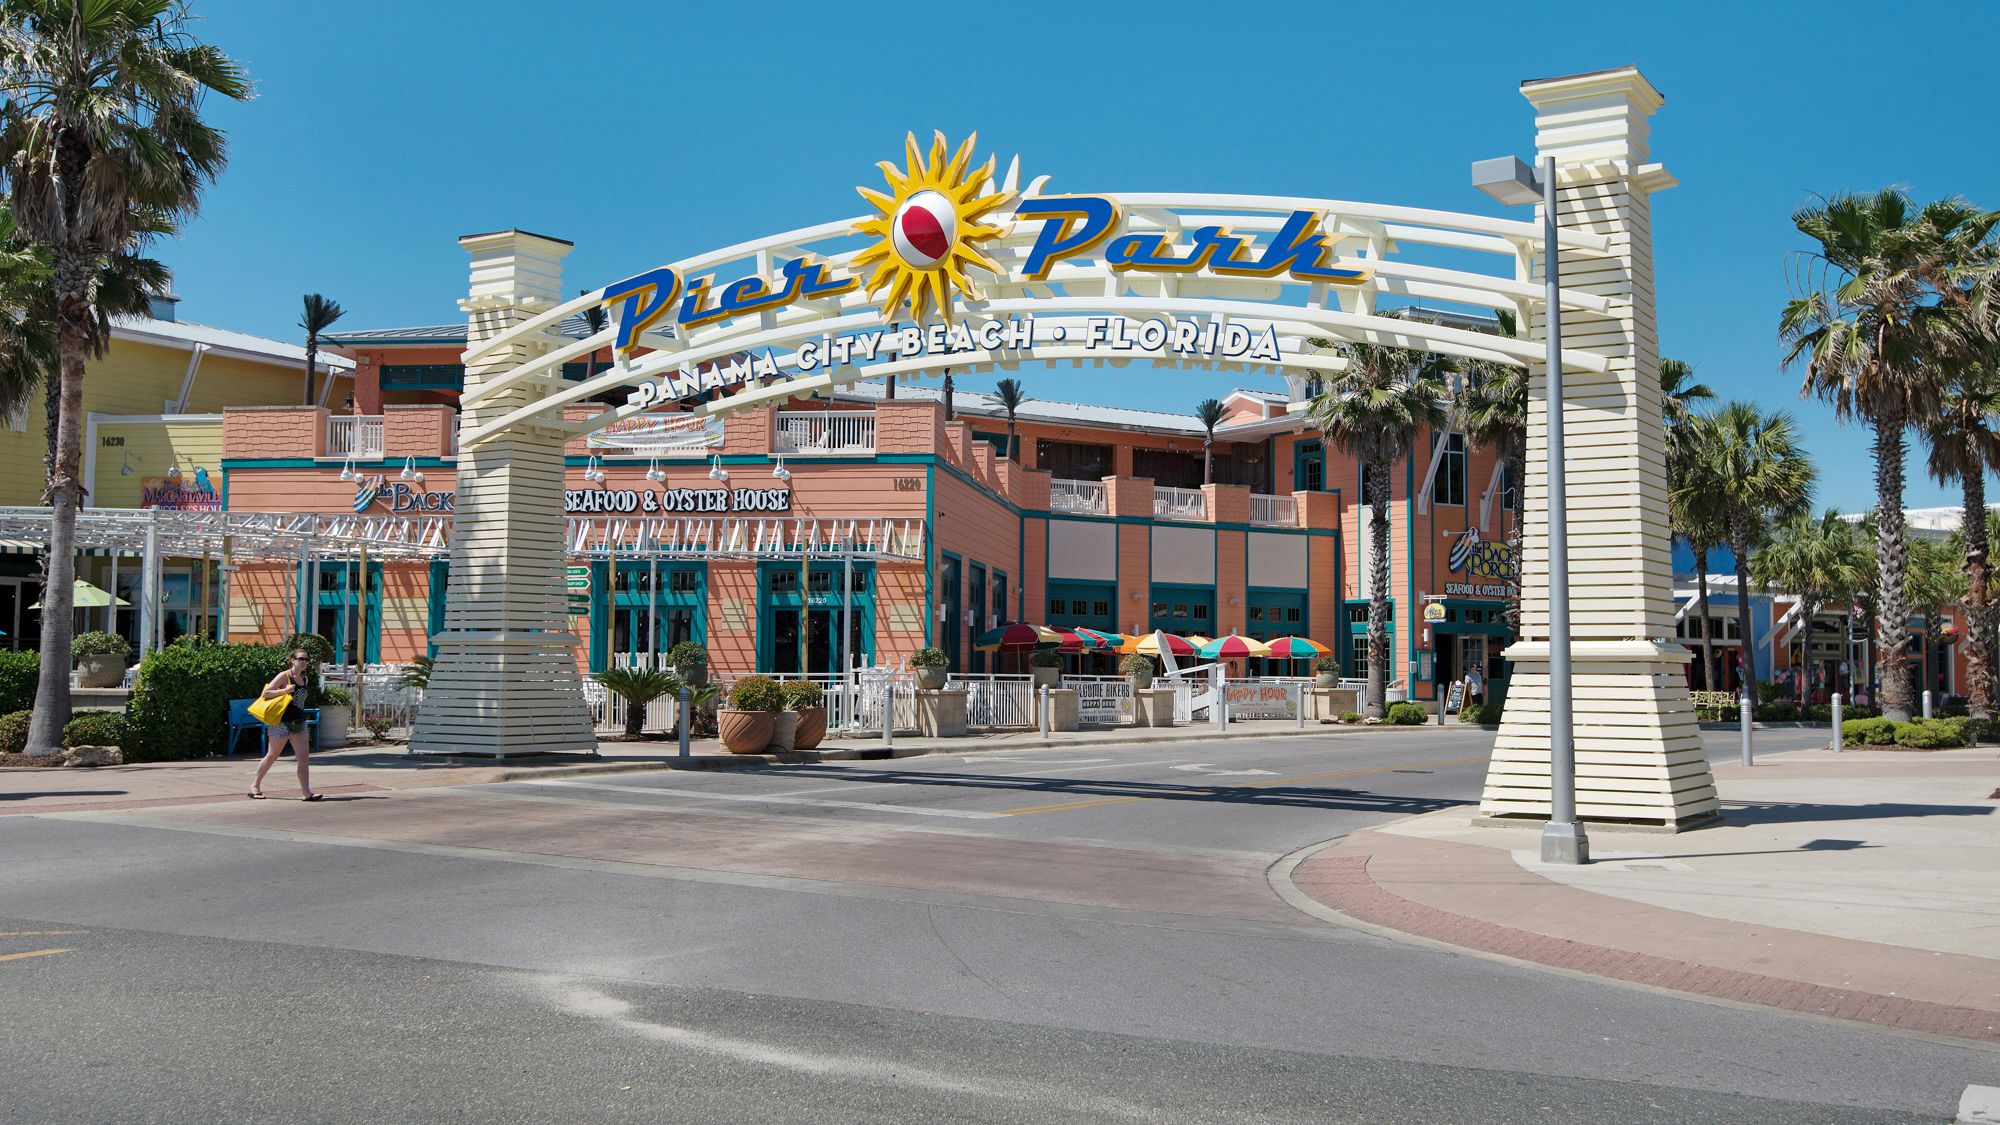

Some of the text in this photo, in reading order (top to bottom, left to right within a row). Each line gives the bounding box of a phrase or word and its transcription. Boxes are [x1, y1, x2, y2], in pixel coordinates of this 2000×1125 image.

[602, 195, 1376, 355] Pier Park
[638, 317, 1282, 410] PANAMA CITY BEACH FLORIDA
[604, 416, 707, 433] HAPPY HOUR
[102, 437, 125, 447] 16230
[392, 482, 454, 511] BACK
[565, 488, 790, 512] SEAFOOD & OYSTER HOUSE
[1445, 582, 1475, 595] SEAFOOD
[1475, 584, 1482, 596] &
[1482, 584, 1506, 597] OYSTER
[1105, 683, 1130, 698] BIKERS
[1260, 687, 1288, 701] HOUR
